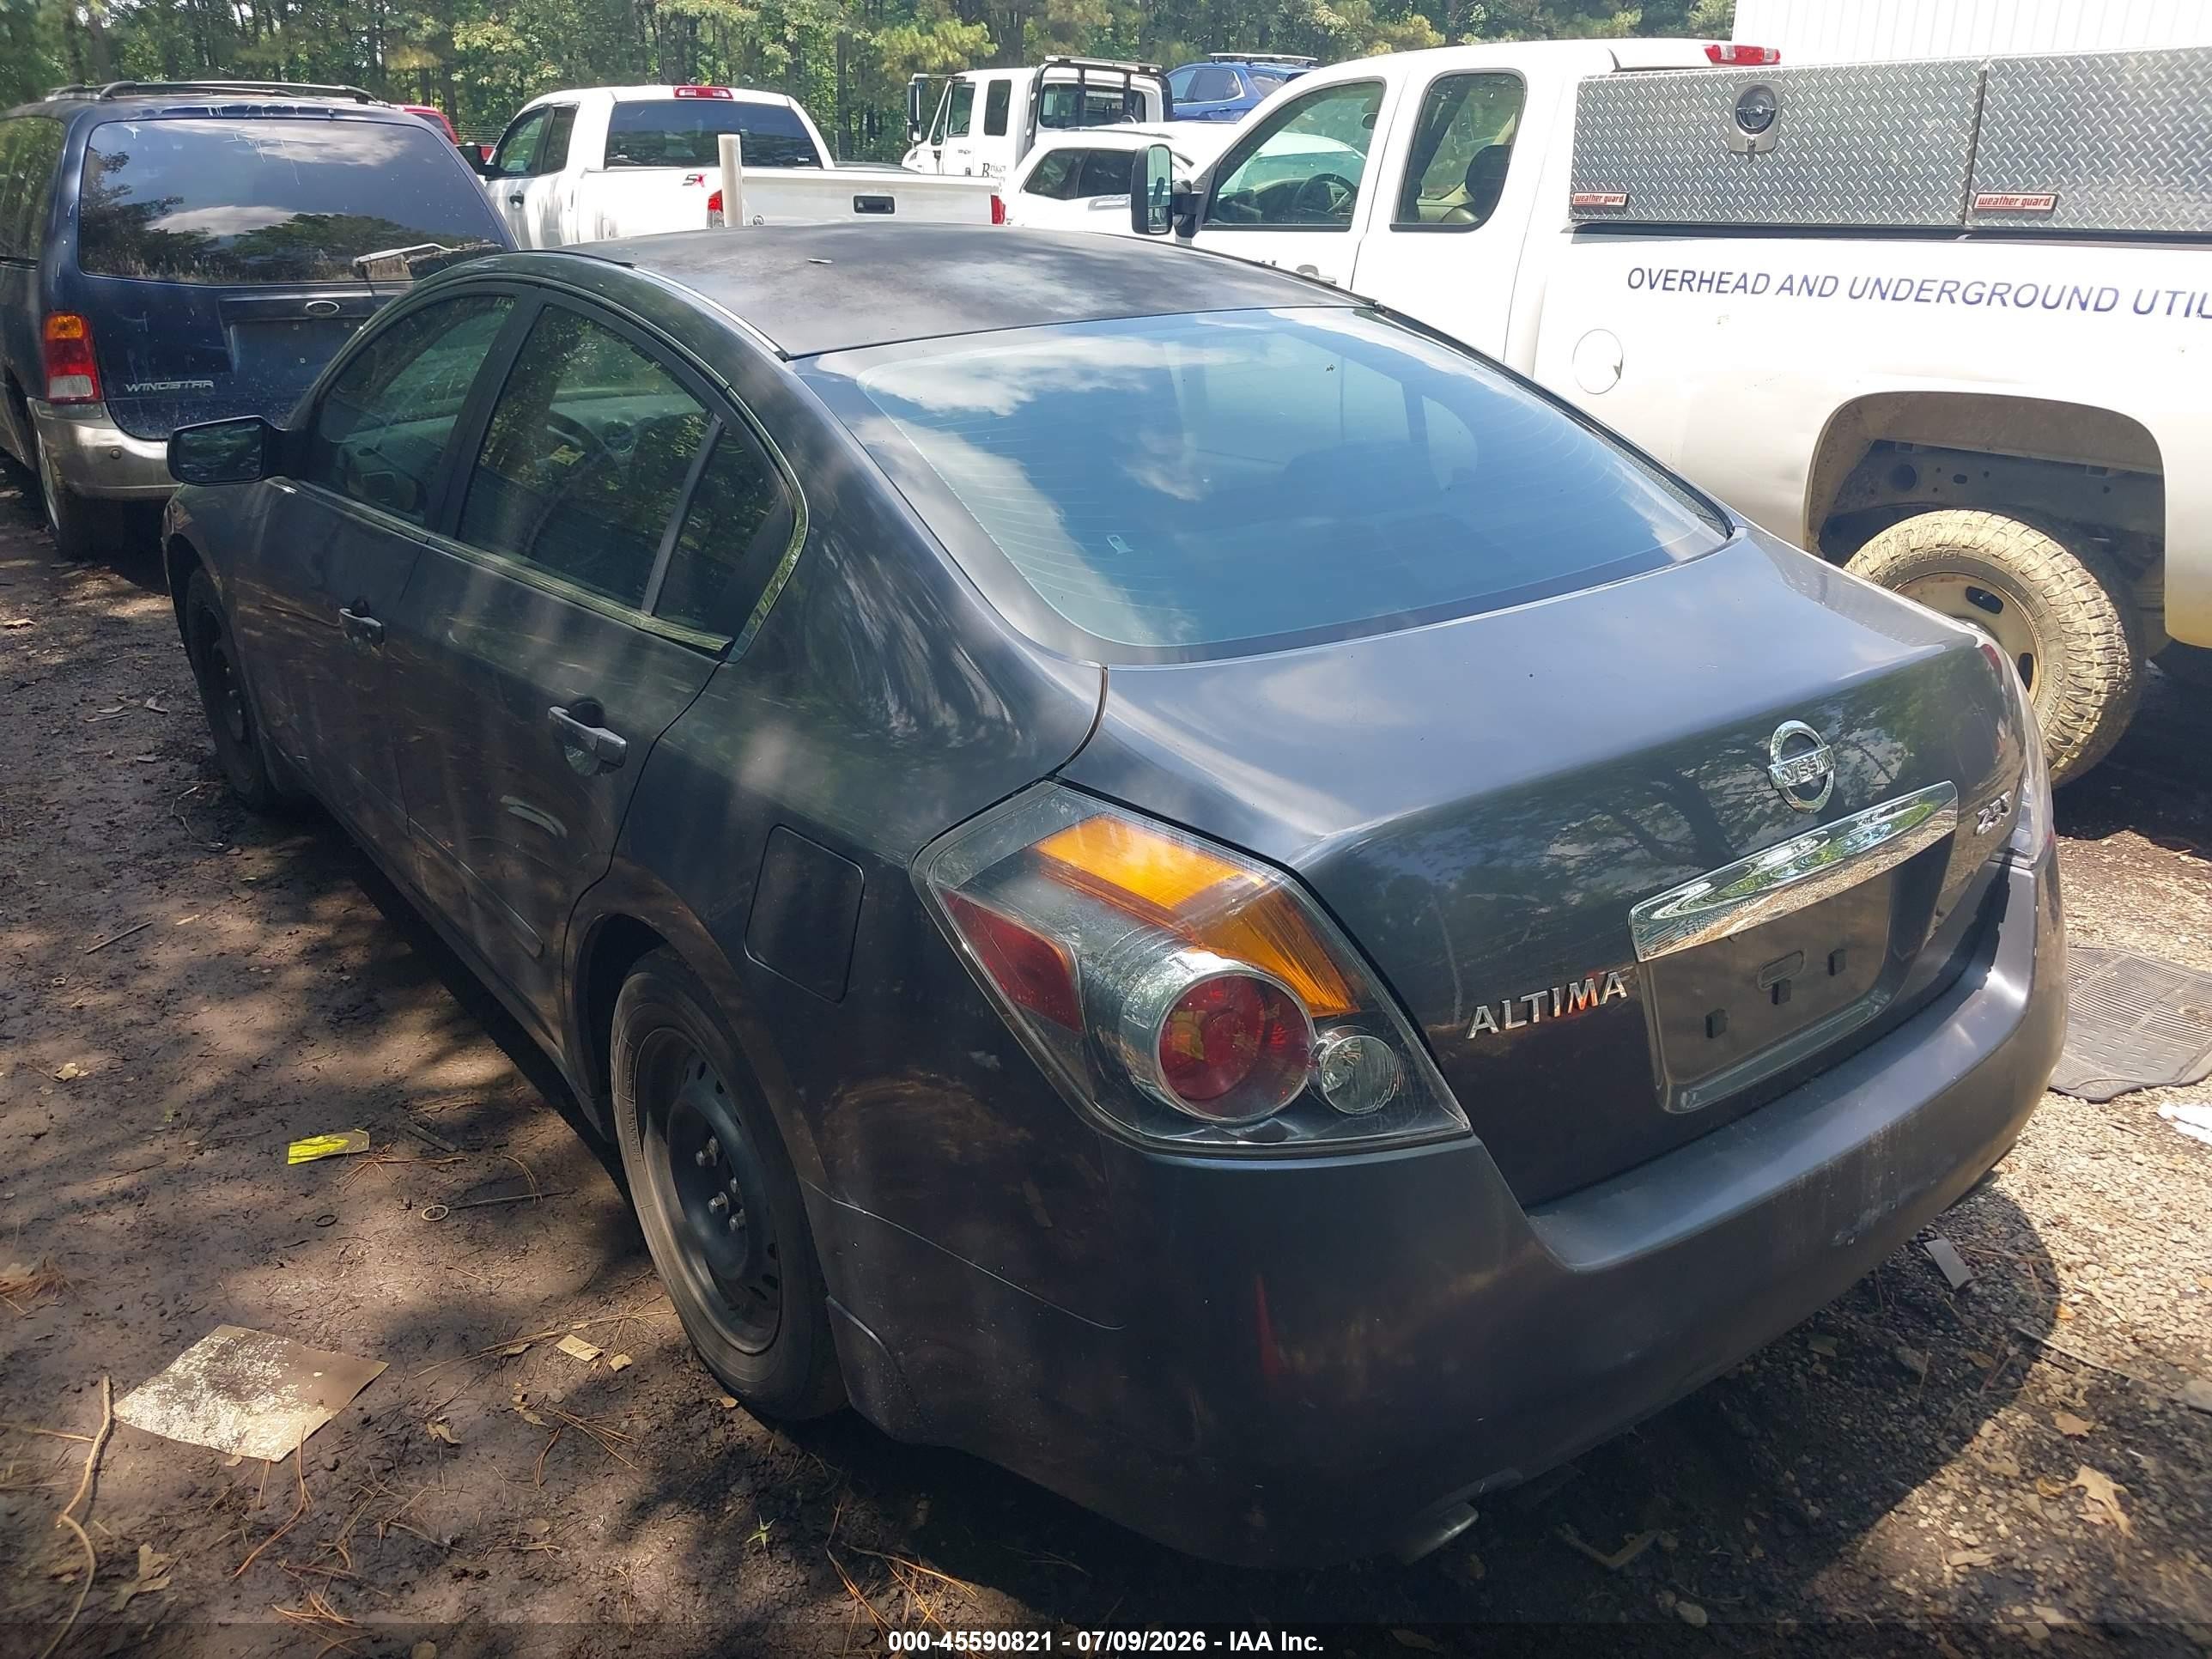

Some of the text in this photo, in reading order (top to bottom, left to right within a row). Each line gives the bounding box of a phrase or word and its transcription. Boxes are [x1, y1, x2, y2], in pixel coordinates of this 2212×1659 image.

[1575, 193, 1625, 204] weather guard
[1978, 196, 2052, 206] weather guard
[1627, 267, 1771, 295] OVERHEAD
[1775, 273, 1839, 298] AND
[1848, 276, 2120, 313] UNDERGROUND
[125, 380, 214, 392] WINDSTAR
[1770, 747, 1833, 785] NISSAN
[1466, 971, 1628, 1039] ALTIMA
